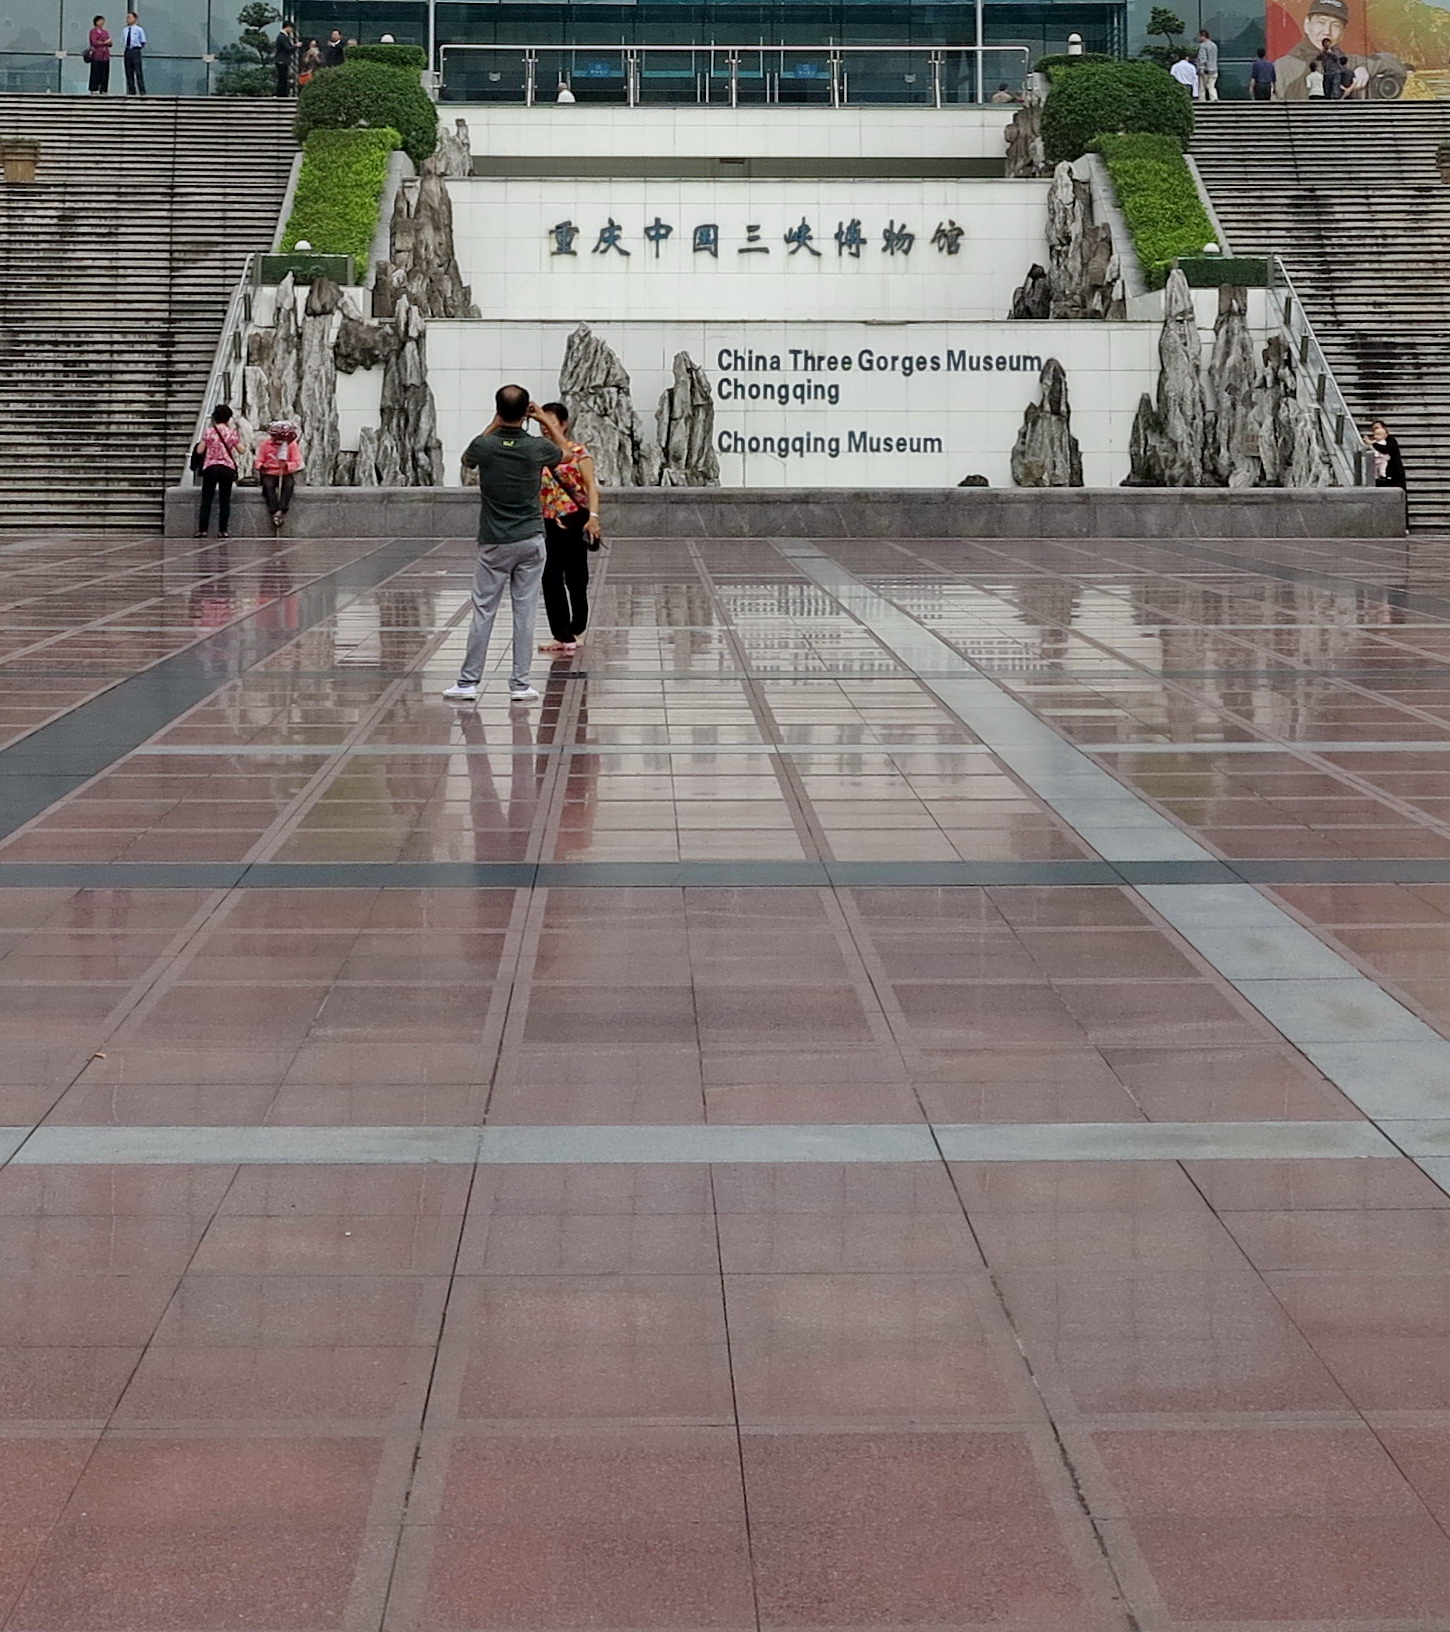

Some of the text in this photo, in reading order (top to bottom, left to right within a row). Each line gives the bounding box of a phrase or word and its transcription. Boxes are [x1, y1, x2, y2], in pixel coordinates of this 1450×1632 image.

[549, 217, 965, 258] 重庆中国三峡博物馆
[717, 349, 1042, 376] China Three Gorges Museum
[717, 378, 840, 404] Chongqing
[717, 430, 942, 458] Chongqing Museum
